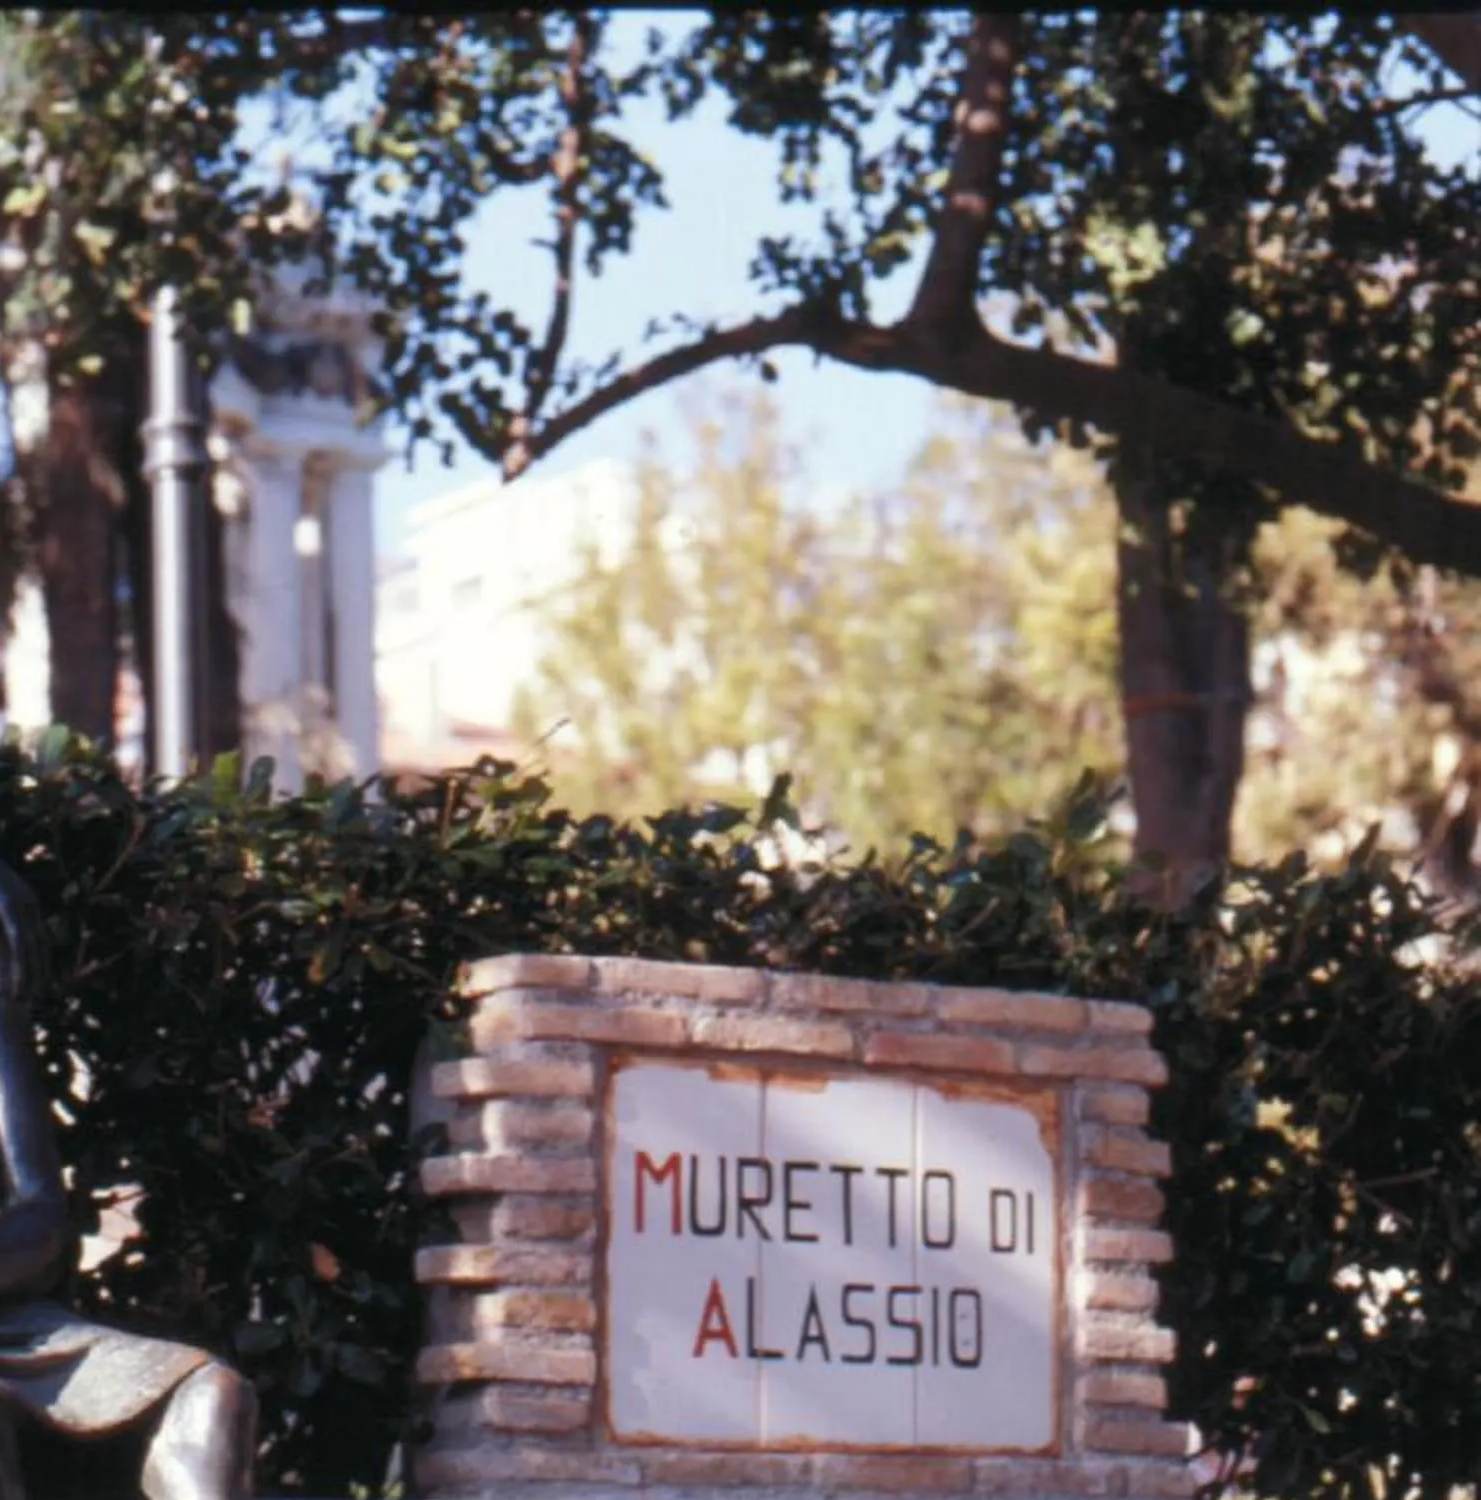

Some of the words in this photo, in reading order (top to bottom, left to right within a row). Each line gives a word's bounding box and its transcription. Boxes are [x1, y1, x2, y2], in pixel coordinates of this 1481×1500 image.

[633, 1150, 956, 1250] MURETTO
[989, 1188, 1035, 1254] DI
[692, 1275, 983, 1369] ALASSIO
